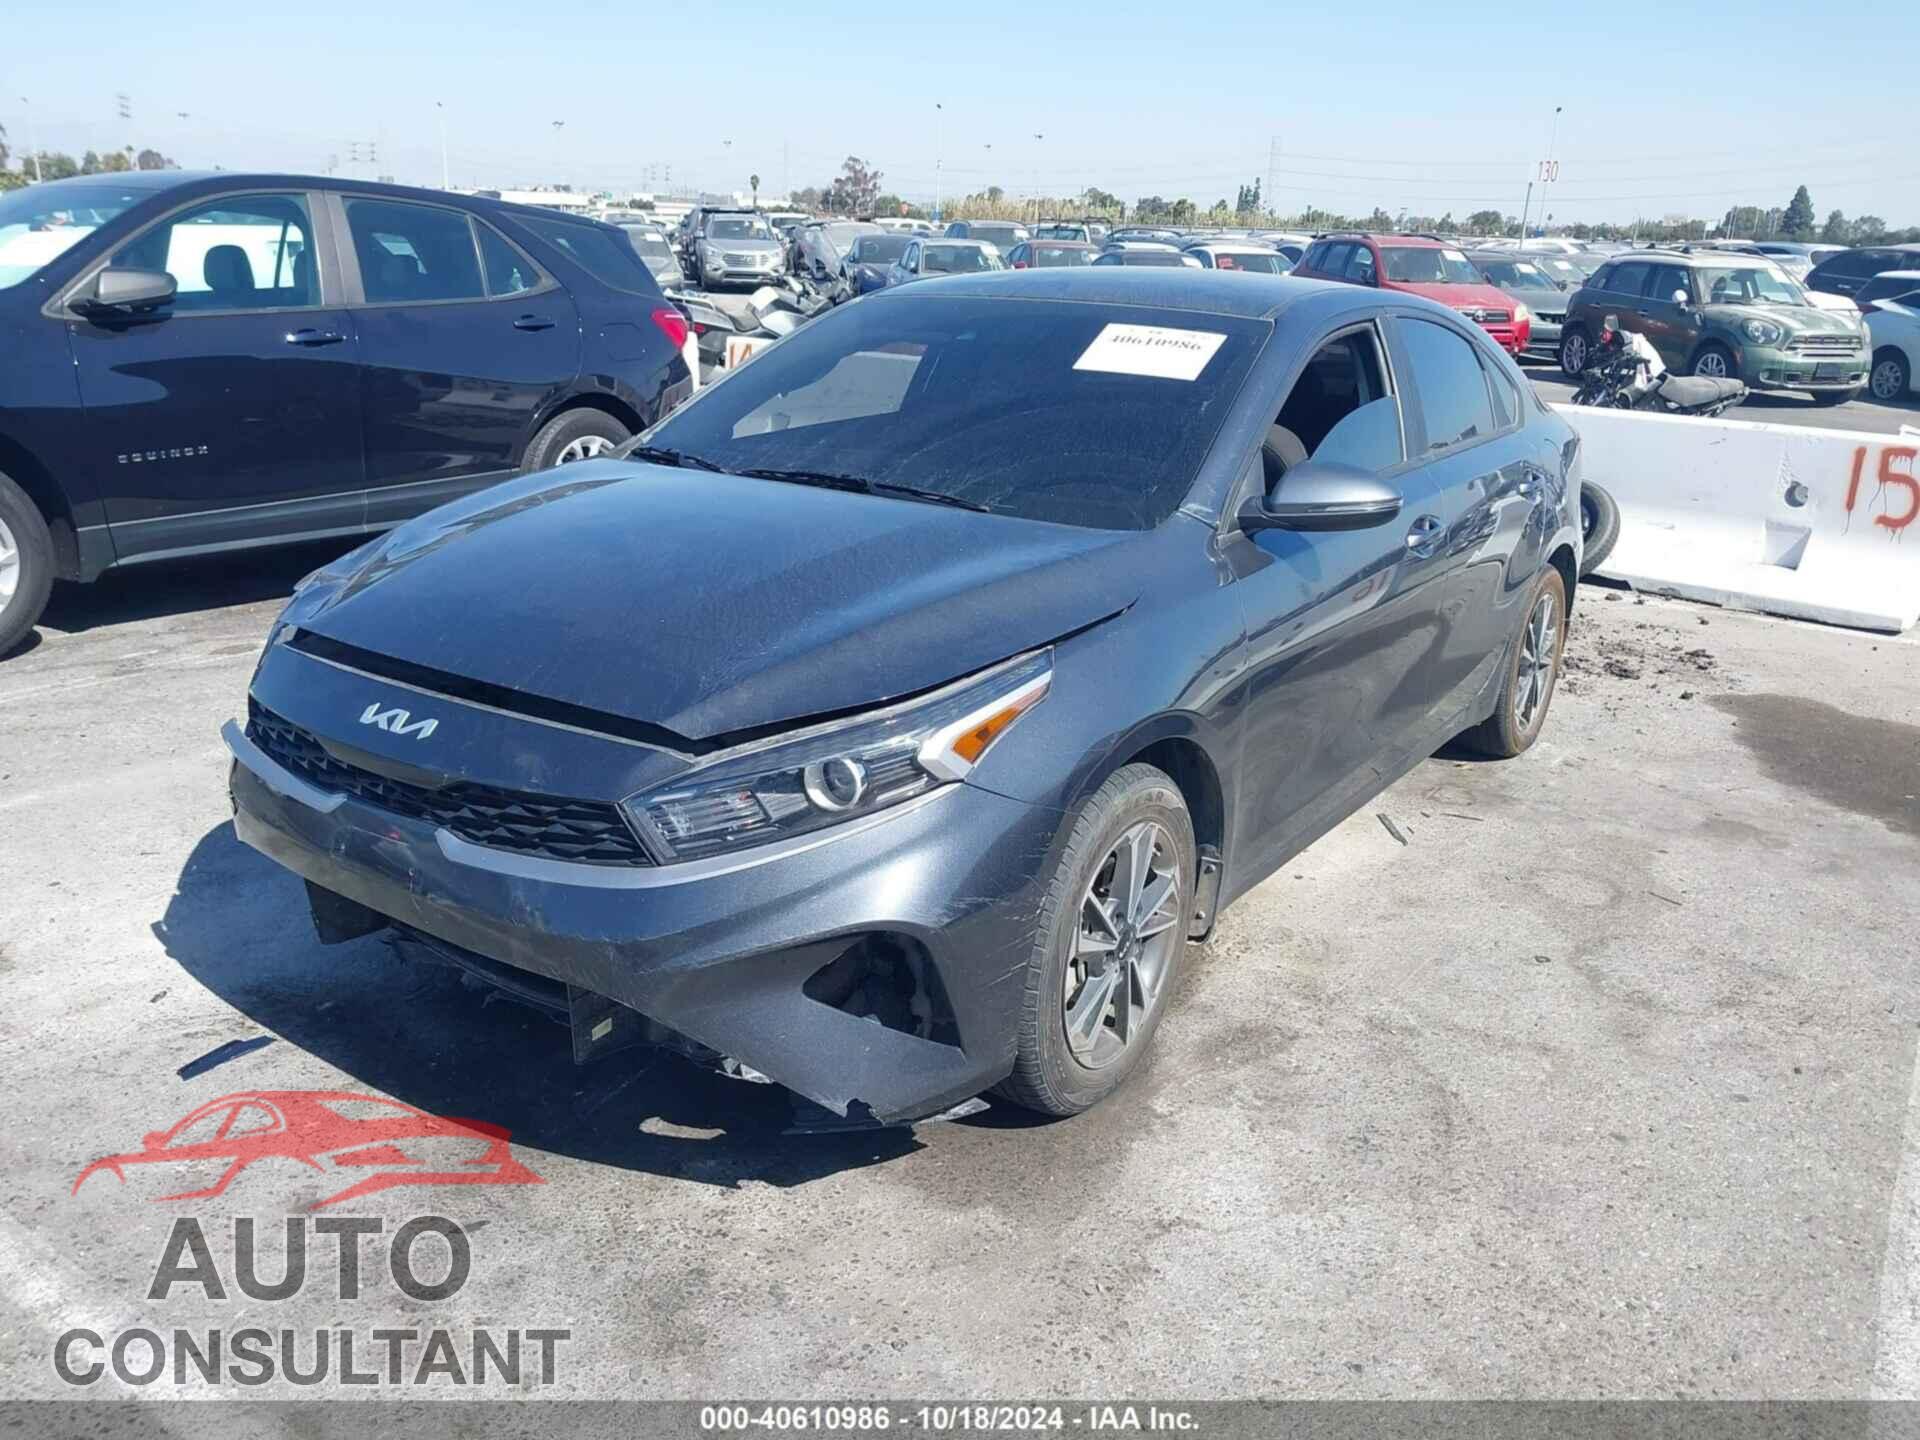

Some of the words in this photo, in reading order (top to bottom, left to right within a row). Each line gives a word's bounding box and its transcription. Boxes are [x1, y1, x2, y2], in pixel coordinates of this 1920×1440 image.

[1537, 160, 1559, 182] 130
[117, 445, 209, 464] EQUINOX
[1844, 445, 1920, 529] 15
[359, 702, 439, 740] KIA
